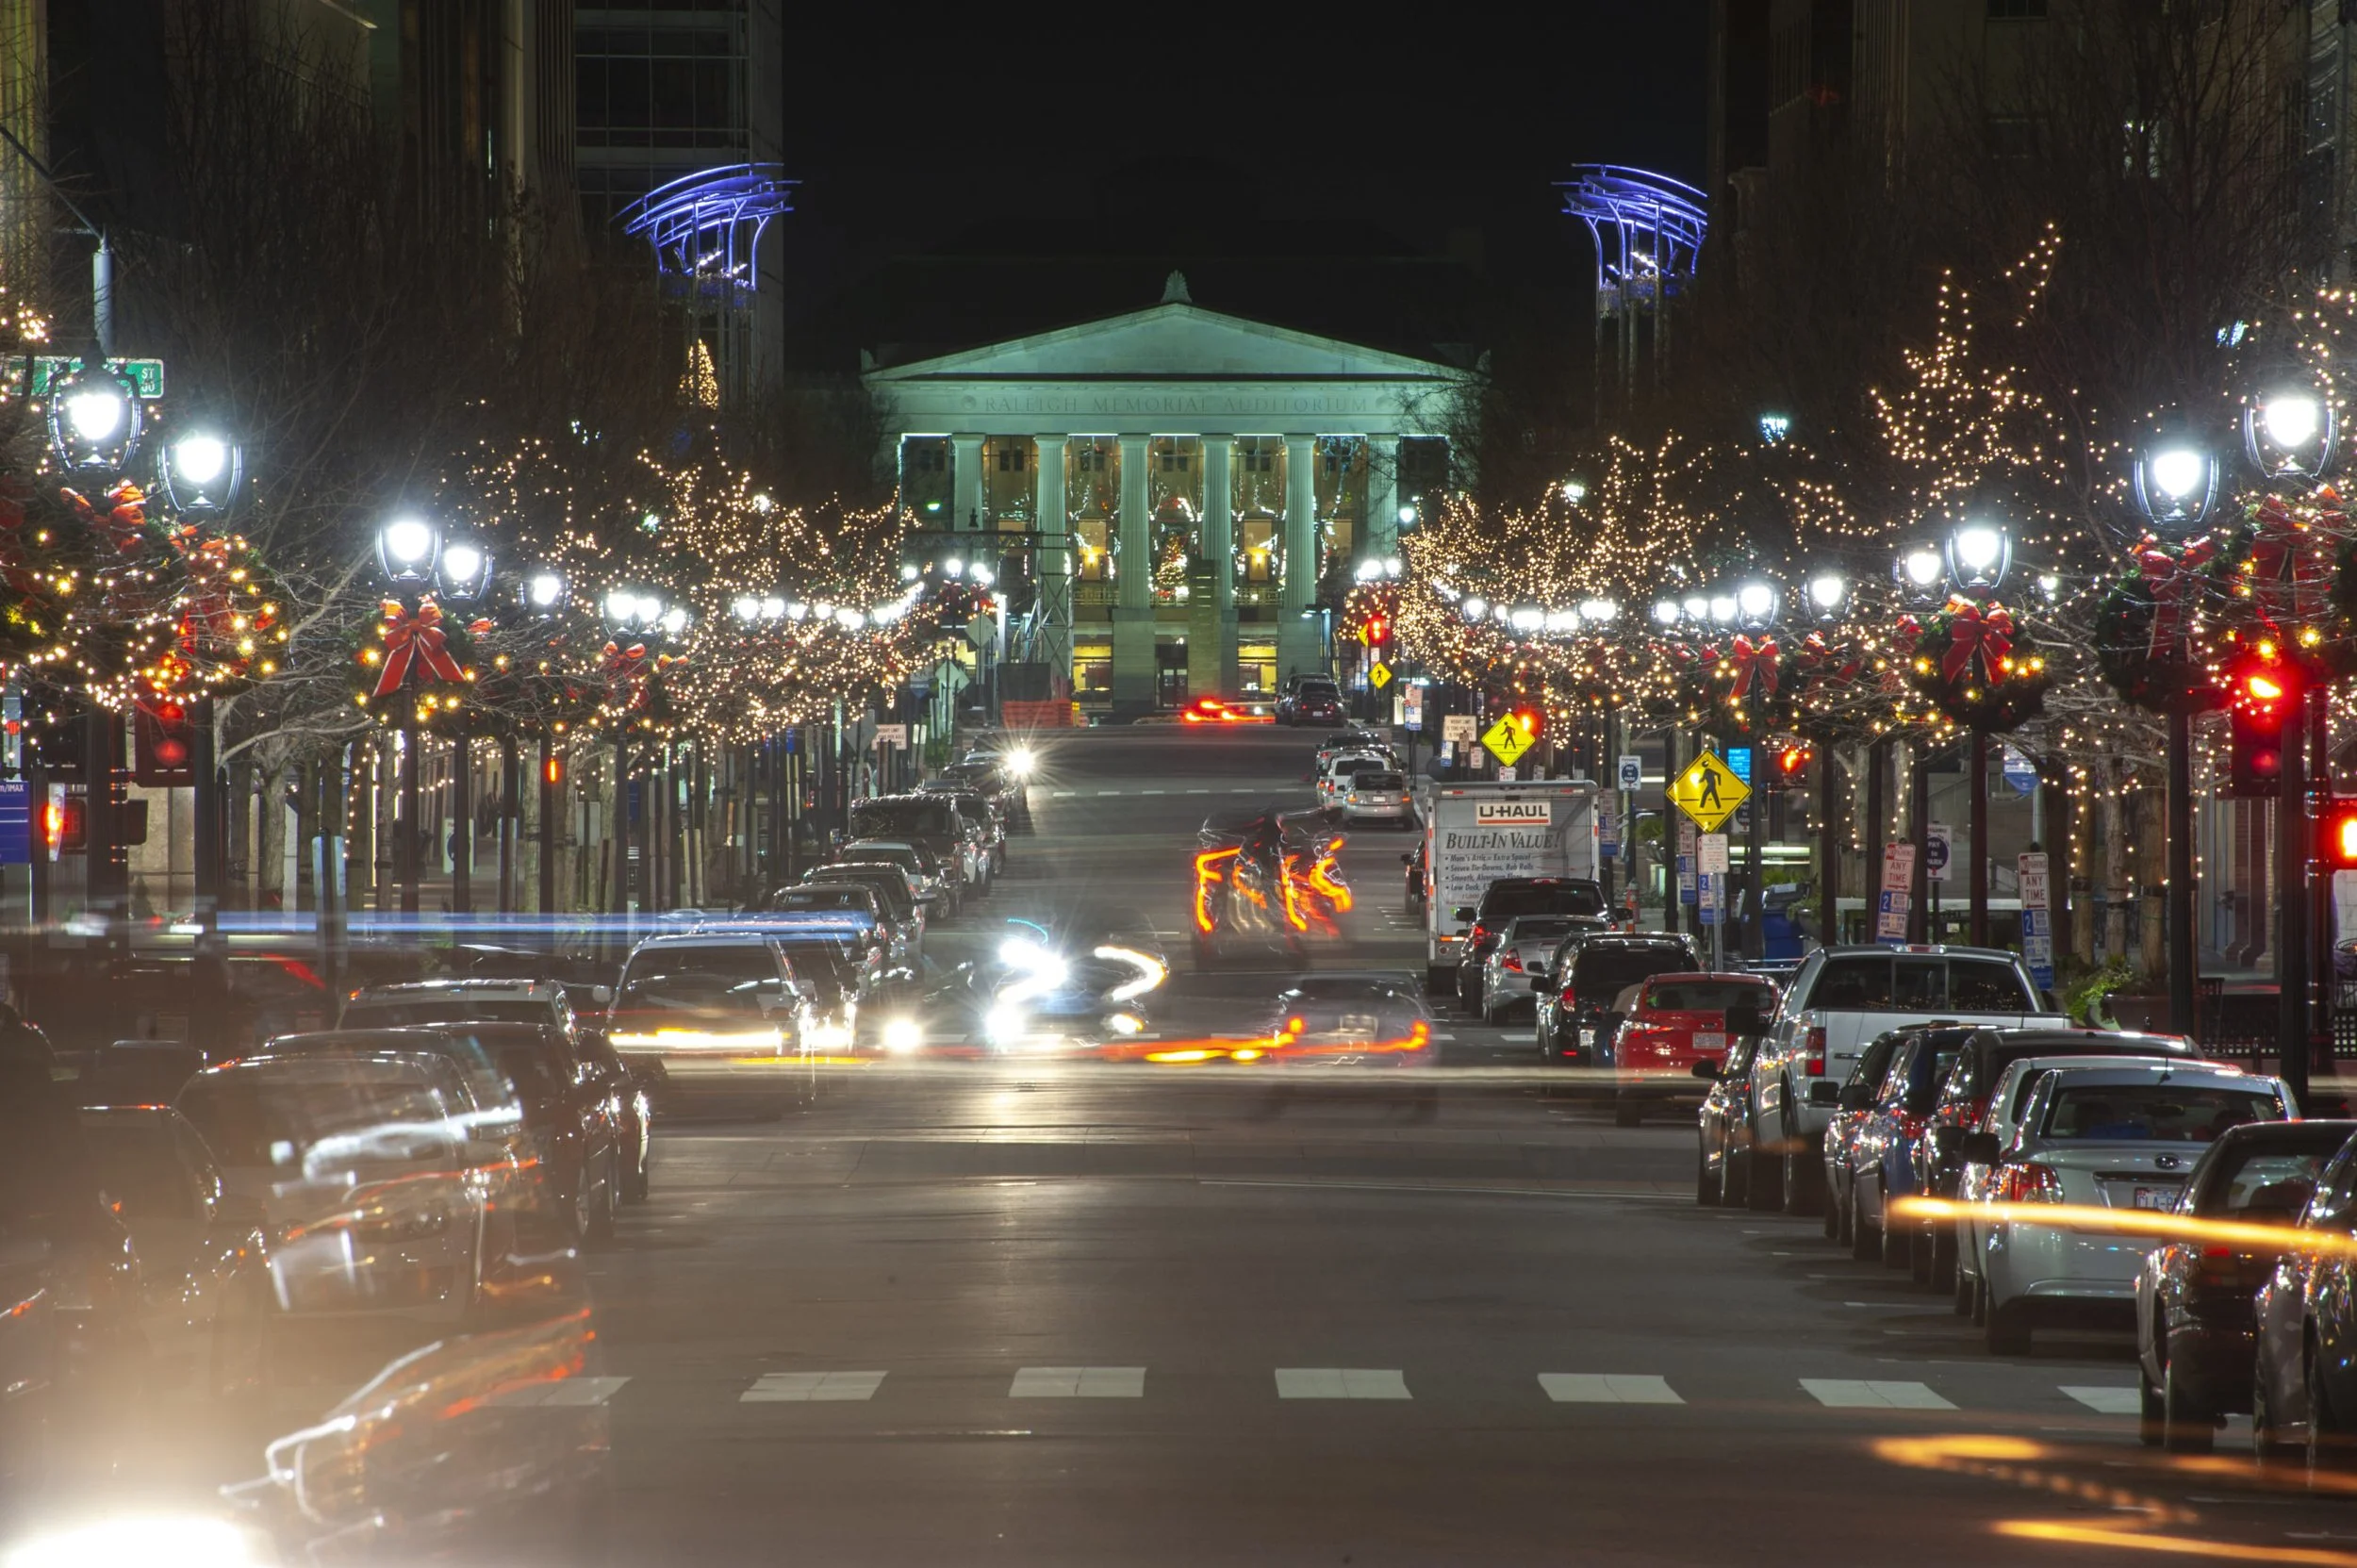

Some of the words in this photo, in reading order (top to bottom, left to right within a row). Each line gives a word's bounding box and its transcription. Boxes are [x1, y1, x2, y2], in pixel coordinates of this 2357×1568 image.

[141, 368, 155, 379] ST
[985, 397, 1078, 412] RALEIGH
[1094, 396, 1207, 412] MEMORIAL
[1225, 396, 1367, 412] AUDITORIUM
[1479, 805, 1548, 817] U-HAUL
[1446, 832, 1508, 850] BUILT-IN
[1509, 832, 1561, 850] VALUE!
[1890, 862, 1906, 871] ANY
[1701, 877, 1707, 889] 2
[1889, 873, 1907, 883] TIME
[2026, 876, 2043, 886] ANY
[2025, 889, 2045, 900] TIME
[1882, 895, 1889, 910] 2
[2025, 915, 2032, 933] 2
